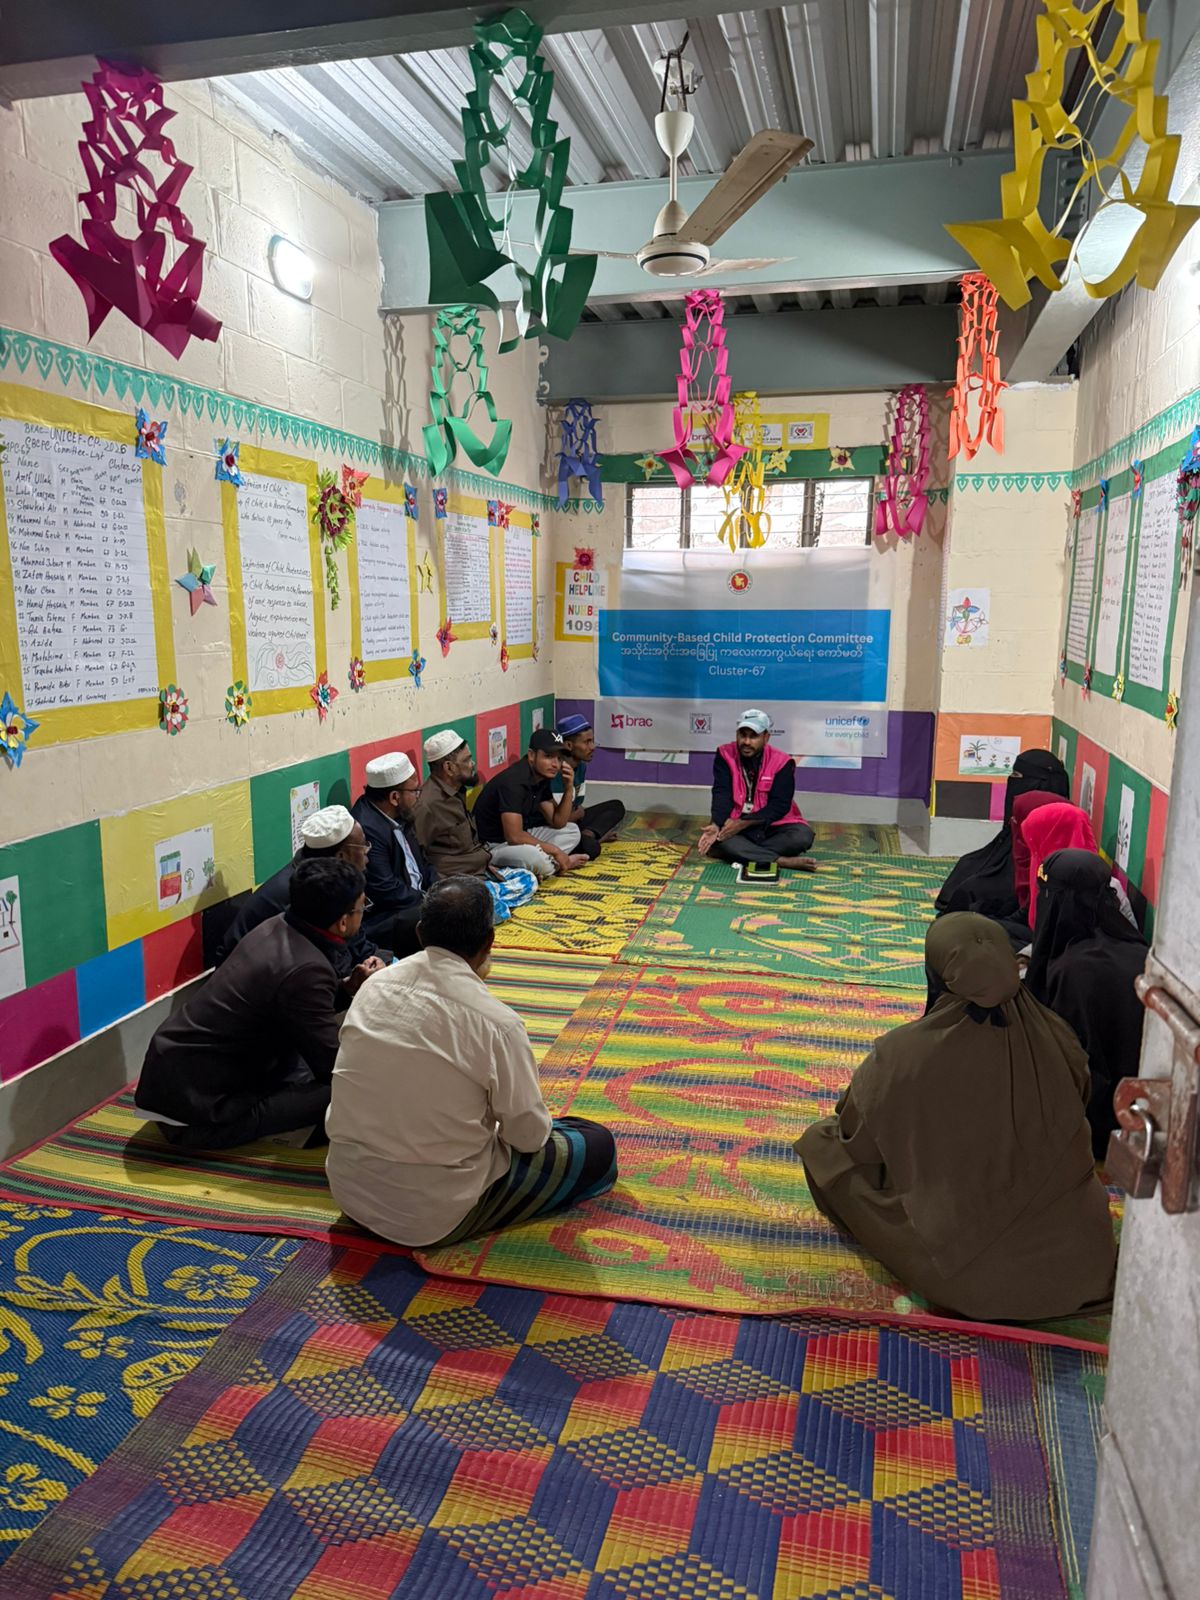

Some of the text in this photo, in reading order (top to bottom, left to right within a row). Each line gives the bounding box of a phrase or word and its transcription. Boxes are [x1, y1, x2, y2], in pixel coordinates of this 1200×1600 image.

[573, 571, 600, 584] CHILD
[612, 631, 874, 645] Community-Based Child Protection Committee
[708, 665, 766, 677] Cluster-67
[625, 714, 654, 728] brac
[825, 715, 857, 727] unicef
